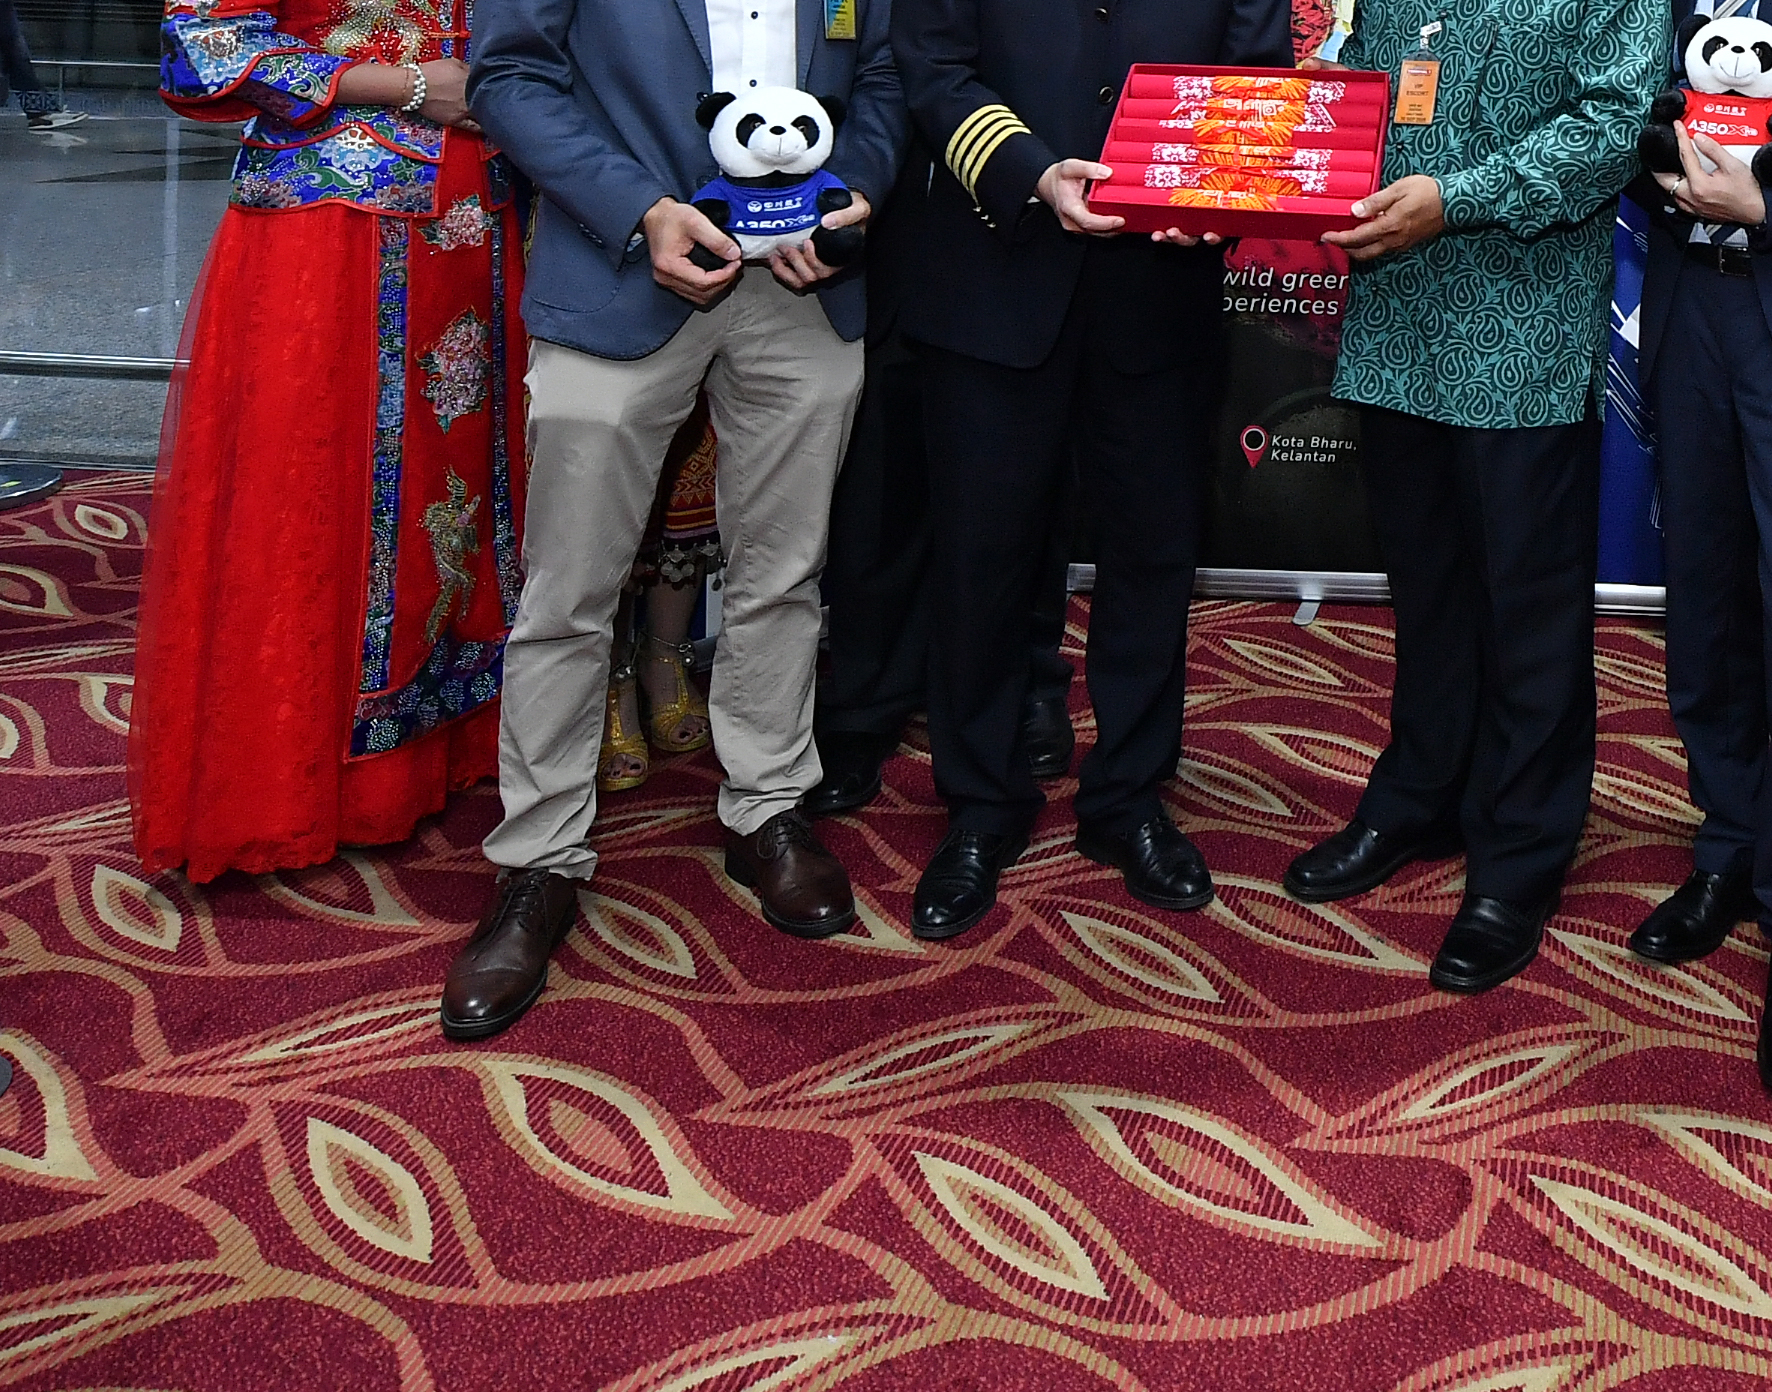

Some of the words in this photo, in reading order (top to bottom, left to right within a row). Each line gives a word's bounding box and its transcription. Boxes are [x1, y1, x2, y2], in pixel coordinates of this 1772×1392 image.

[1271, 434, 1304, 449] Kota
[1310, 436, 1357, 451] Bharu,
[1270, 449, 1336, 464] Kelantan
